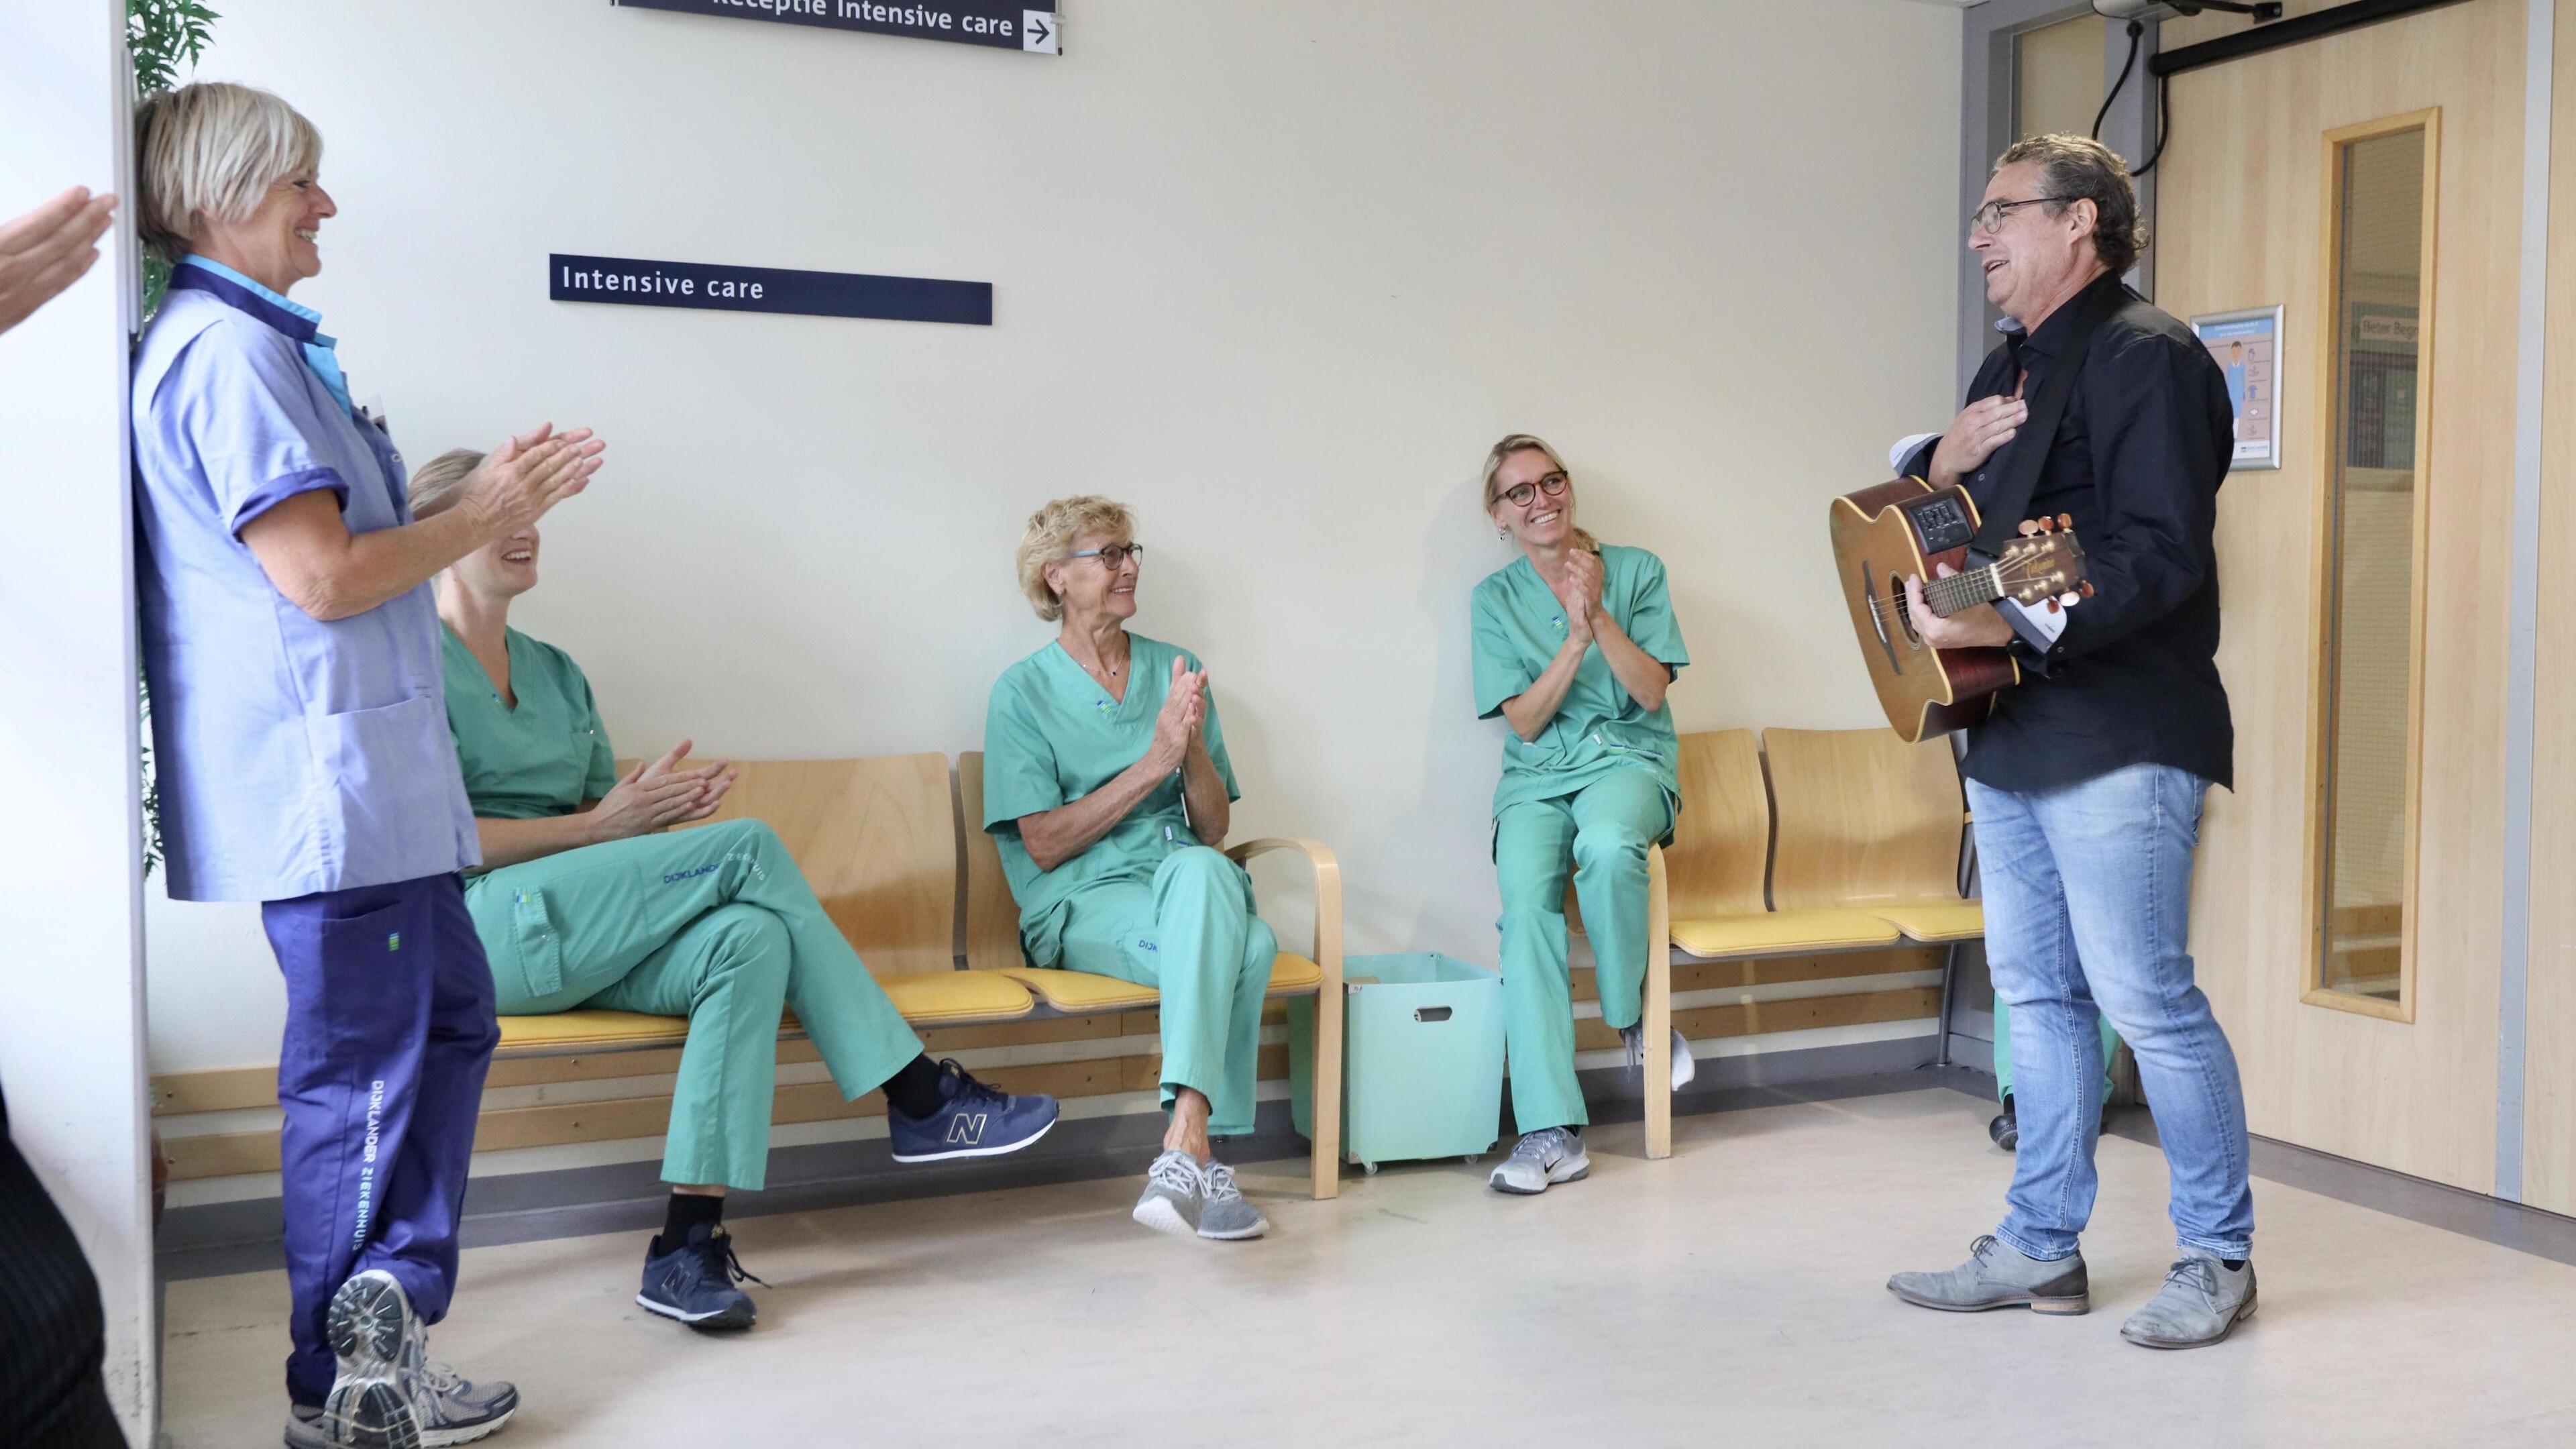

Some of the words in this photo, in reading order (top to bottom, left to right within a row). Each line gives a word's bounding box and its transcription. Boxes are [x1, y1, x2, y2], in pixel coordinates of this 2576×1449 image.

[713, 0, 826, 15] eptie
[838, 0, 952, 30] Intensive
[962, 15, 1013, 36] care
[563, 266, 694, 295] Intensive
[707, 280, 763, 299] care
[363, 1080, 384, 1163] DIJKLANDER
[947, 1113, 987, 1144] N
[352, 1167, 374, 1251] ZIEKENHUIS
